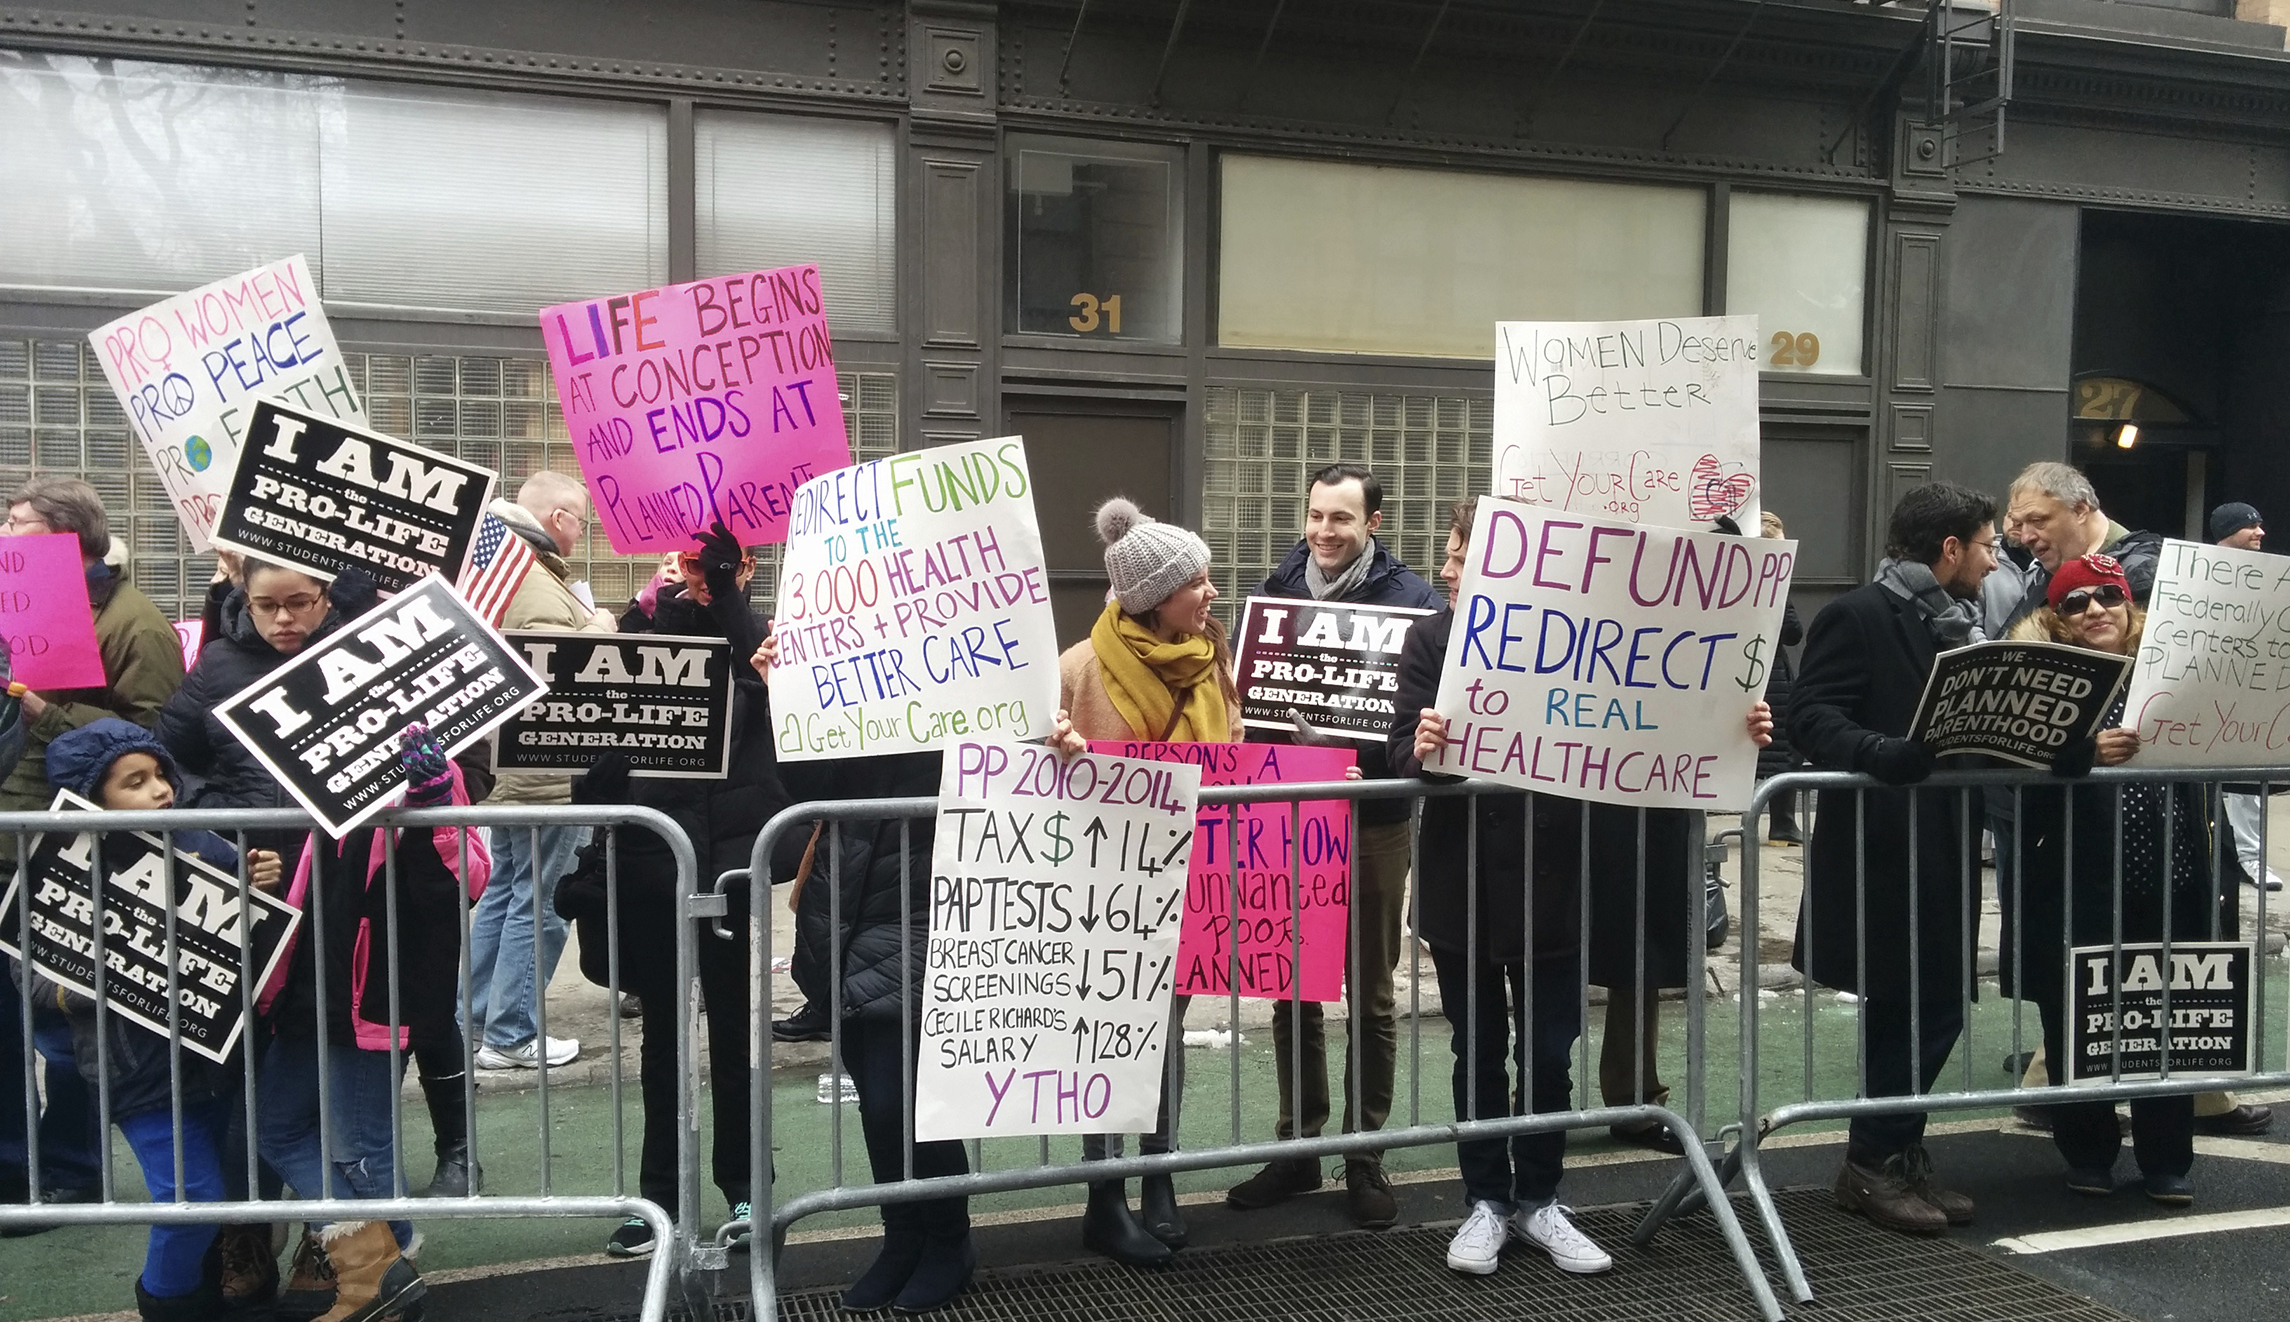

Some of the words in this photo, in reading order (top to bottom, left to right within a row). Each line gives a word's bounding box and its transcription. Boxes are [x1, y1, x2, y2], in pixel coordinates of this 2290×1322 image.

[105, 315, 172, 392] PRO
[175, 263, 306, 350] WOMEN
[557, 290, 666, 367] LIFE
[684, 268, 820, 338] BEGINS
[1069, 292, 1121, 333] 31
[570, 372, 597, 415] AT
[611, 320, 834, 409] CONCEPTION
[1503, 326, 1645, 387] WOMEN
[1658, 321, 1757, 367] Deserve
[1769, 331, 1820, 367] 29
[130, 372, 195, 443] PRO
[201, 310, 324, 403] PEACE
[2080, 384, 2143, 420] 27
[219, 365, 359, 448] ETH
[587, 417, 633, 464] AND
[645, 390, 751, 454] ENDS
[772, 380, 817, 433] AT
[263, 413, 307, 464] I
[315, 437, 469, 516] AM
[250, 474, 450, 558] PRO-LIFE
[343, 488, 368, 504] the
[596, 474, 703, 545] PLANNED
[787, 459, 883, 554] REDIRECT
[889, 444, 1026, 517] FUNDS
[243, 506, 441, 578] GENERATION
[824, 535, 847, 566] TO
[855, 518, 903, 554] THE
[883, 525, 1006, 599] HEALTH
[1481, 510, 1752, 611] DEFUND
[1752, 552, 1793, 609] PP
[2167, 543, 2264, 590] There
[770, 615, 865, 669] CENTERS
[893, 566, 1048, 639] PROVIDE
[1258, 608, 1288, 645] I
[1297, 612, 1413, 655] AM
[2156, 580, 2275, 641] Federally
[249, 686, 312, 739] I
[315, 594, 455, 706] AM
[524, 643, 557, 683] I
[574, 644, 713, 688] AM
[811, 649, 921, 710] BETTER
[922, 618, 1029, 685] CARE
[1319, 653, 1338, 664] the
[1459, 593, 1738, 692] REDIRECT
[1734, 634, 1768, 693] $
[2002, 651, 2026, 663] WE
[2267, 638, 2290, 660] to
[369, 679, 394, 699] the
[605, 690, 628, 700] the
[1250, 659, 1399, 692] PRO-LIFE
[1940, 666, 2009, 697] DON'T
[2010, 667, 2093, 699] NEED
[2142, 646, 2290, 693] PLANNED
[298, 641, 488, 774] PRO-LIFE
[519, 702, 710, 728] PRO-LIFE
[1247, 686, 1396, 715] GENERATION
[1465, 678, 1510, 717] to
[1545, 687, 1659, 731] REAL
[1929, 689, 2080, 727] PLANNED
[326, 666, 506, 794] GENEATION
[518, 731, 707, 750] GENERATION
[1923, 714, 2068, 747] PARENTHOOD
[1936, 734, 2056, 760] TUDENTSFORLIFE.ORG
[958, 743, 1008, 799] PP
[1011, 748, 1186, 816] 2010-2014
[1257, 746, 1281, 781] A
[1438, 718, 1718, 799] HEALTHCARE
[1120, 820, 1193, 878] 14%
[1281, 814, 1349, 868] HOW
[109, 852, 269, 948] AM
[132, 906, 157, 927] the
[1105, 883, 1180, 941] 64%
[34, 877, 237, 996] PRO-LIFE
[933, 972, 1071, 1003] SCREENINGS
[1097, 950, 1171, 1002] 51%
[1176, 953, 1293, 993] ANNED
[2087, 957, 2109, 996] I
[2121, 953, 2234, 992] AM
[924, 1007, 983, 1037] CECILE
[989, 1006, 1068, 1032] RICHARD'S
[2086, 1008, 2234, 1034] PRO-LIFE
[2145, 997, 2163, 1006] the
[940, 1033, 1038, 1069] SALARY
[1091, 1020, 1158, 1065] 128%
